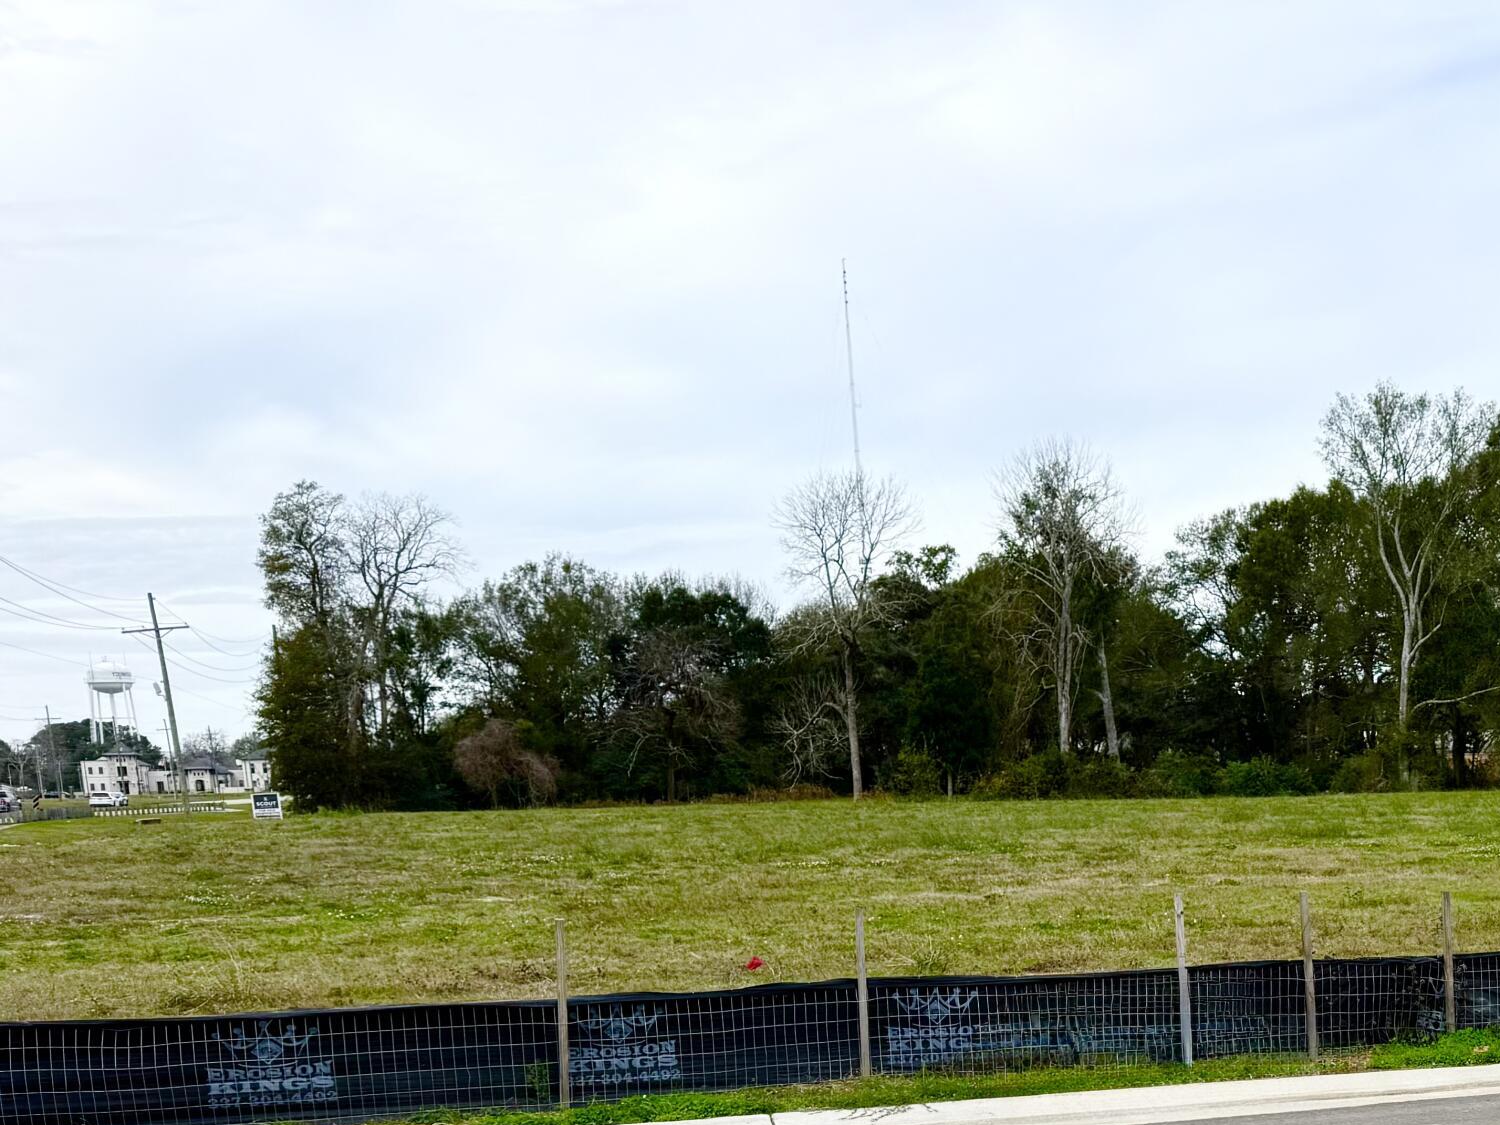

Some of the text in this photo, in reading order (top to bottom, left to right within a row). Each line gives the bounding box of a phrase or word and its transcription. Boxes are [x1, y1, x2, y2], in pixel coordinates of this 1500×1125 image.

[568, 1039, 677, 1059] EROSION
[205, 1060, 333, 1081] EROSION
[568, 1055, 679, 1073] KINGS
[208, 1075, 335, 1095] KINGS
